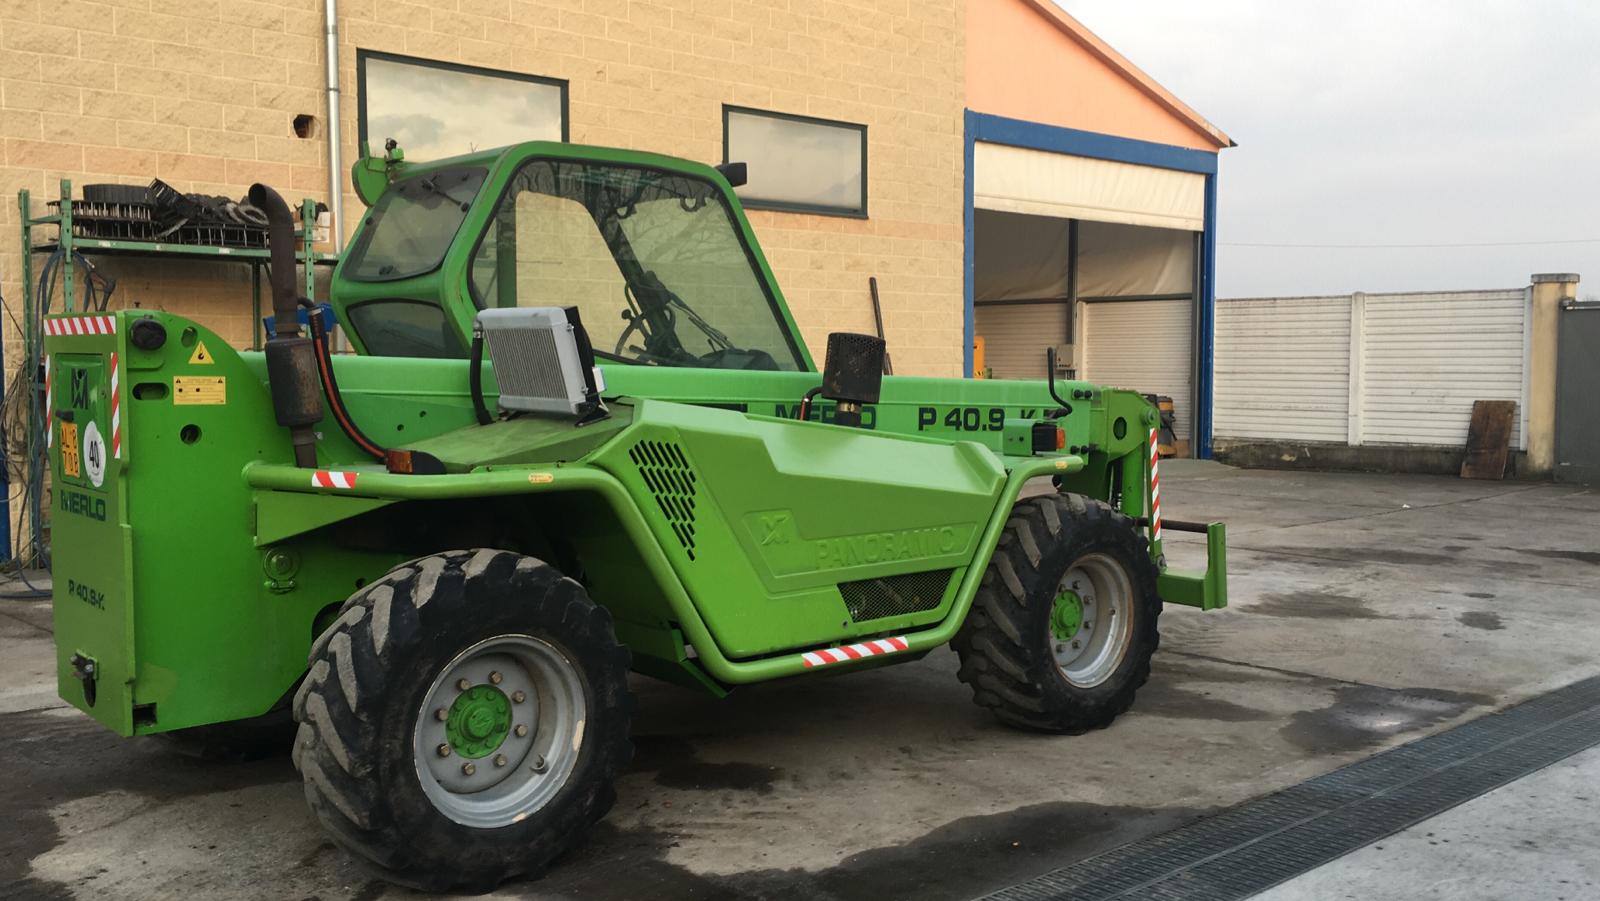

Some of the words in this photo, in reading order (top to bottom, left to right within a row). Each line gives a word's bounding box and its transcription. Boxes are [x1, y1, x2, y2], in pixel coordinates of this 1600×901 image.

[775, 404, 877, 430] MERO
[918, 407, 937, 431] P
[944, 407, 1005, 432] 40.9
[89, 440, 100, 469] 40
[60, 489, 106, 522] MERLO
[816, 525, 954, 570] PANORAMIC
[68, 579, 75, 595] P
